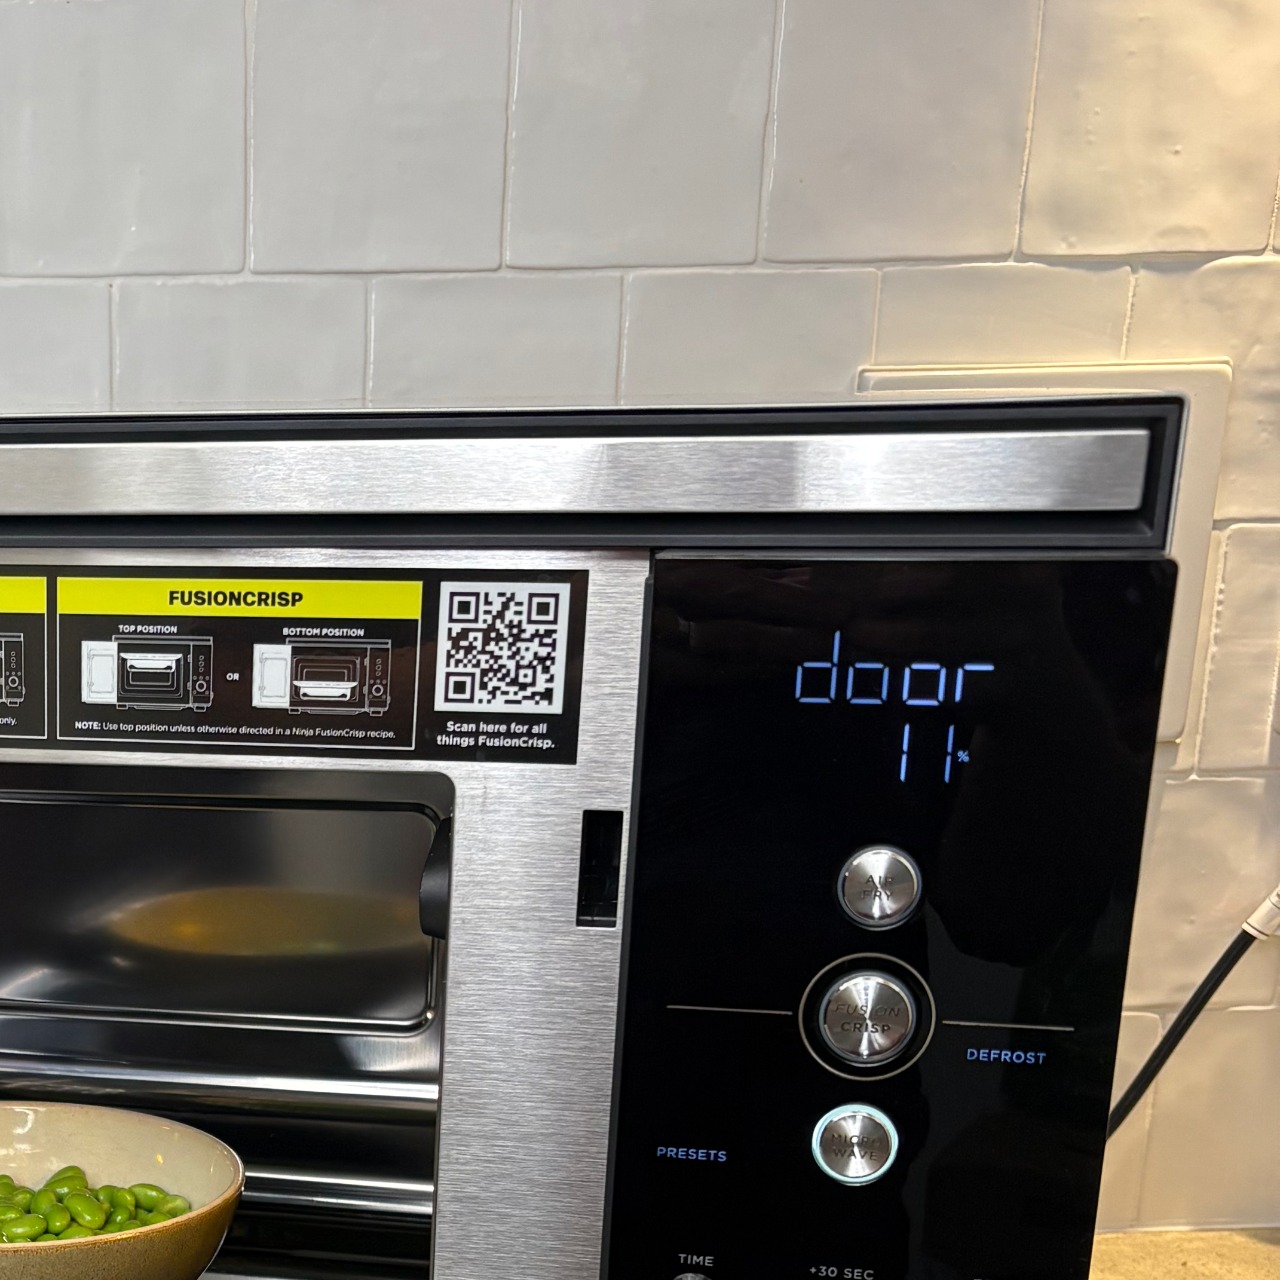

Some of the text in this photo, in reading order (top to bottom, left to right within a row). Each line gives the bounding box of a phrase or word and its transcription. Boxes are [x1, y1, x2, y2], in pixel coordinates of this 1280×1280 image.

[168, 590, 303, 607] FUSIONCRISP
[118, 624, 178, 633] TOP POSITION
[282, 627, 364, 637] BOTTOM POSITION
[795, 630, 995, 706] door
[226, 672, 240, 680] OR
[102, 722, 118, 730] Use
[119, 722, 134, 731] top
[135, 723, 168, 732] position
[169, 724, 195, 732] unless
[196, 725, 238, 734] otherwise
[238, 725, 274, 735] directed
[275, 726, 283, 735] in
[315, 727, 366, 738] FusionCrisp
[446, 721, 547, 734] Scan here for all
[436, 734, 555, 750] things FusionCrisp.
[862, 889, 894, 901] FRY
[840, 1021, 891, 1034] CRISP
[966, 1048, 1046, 1064] DEFROST
[657, 1146, 726, 1162] PRESETS
[832, 1148, 877, 1161] WAVE
[678, 1253, 714, 1266] TIME
[809, 1266, 874, 1280] +30 SEC
